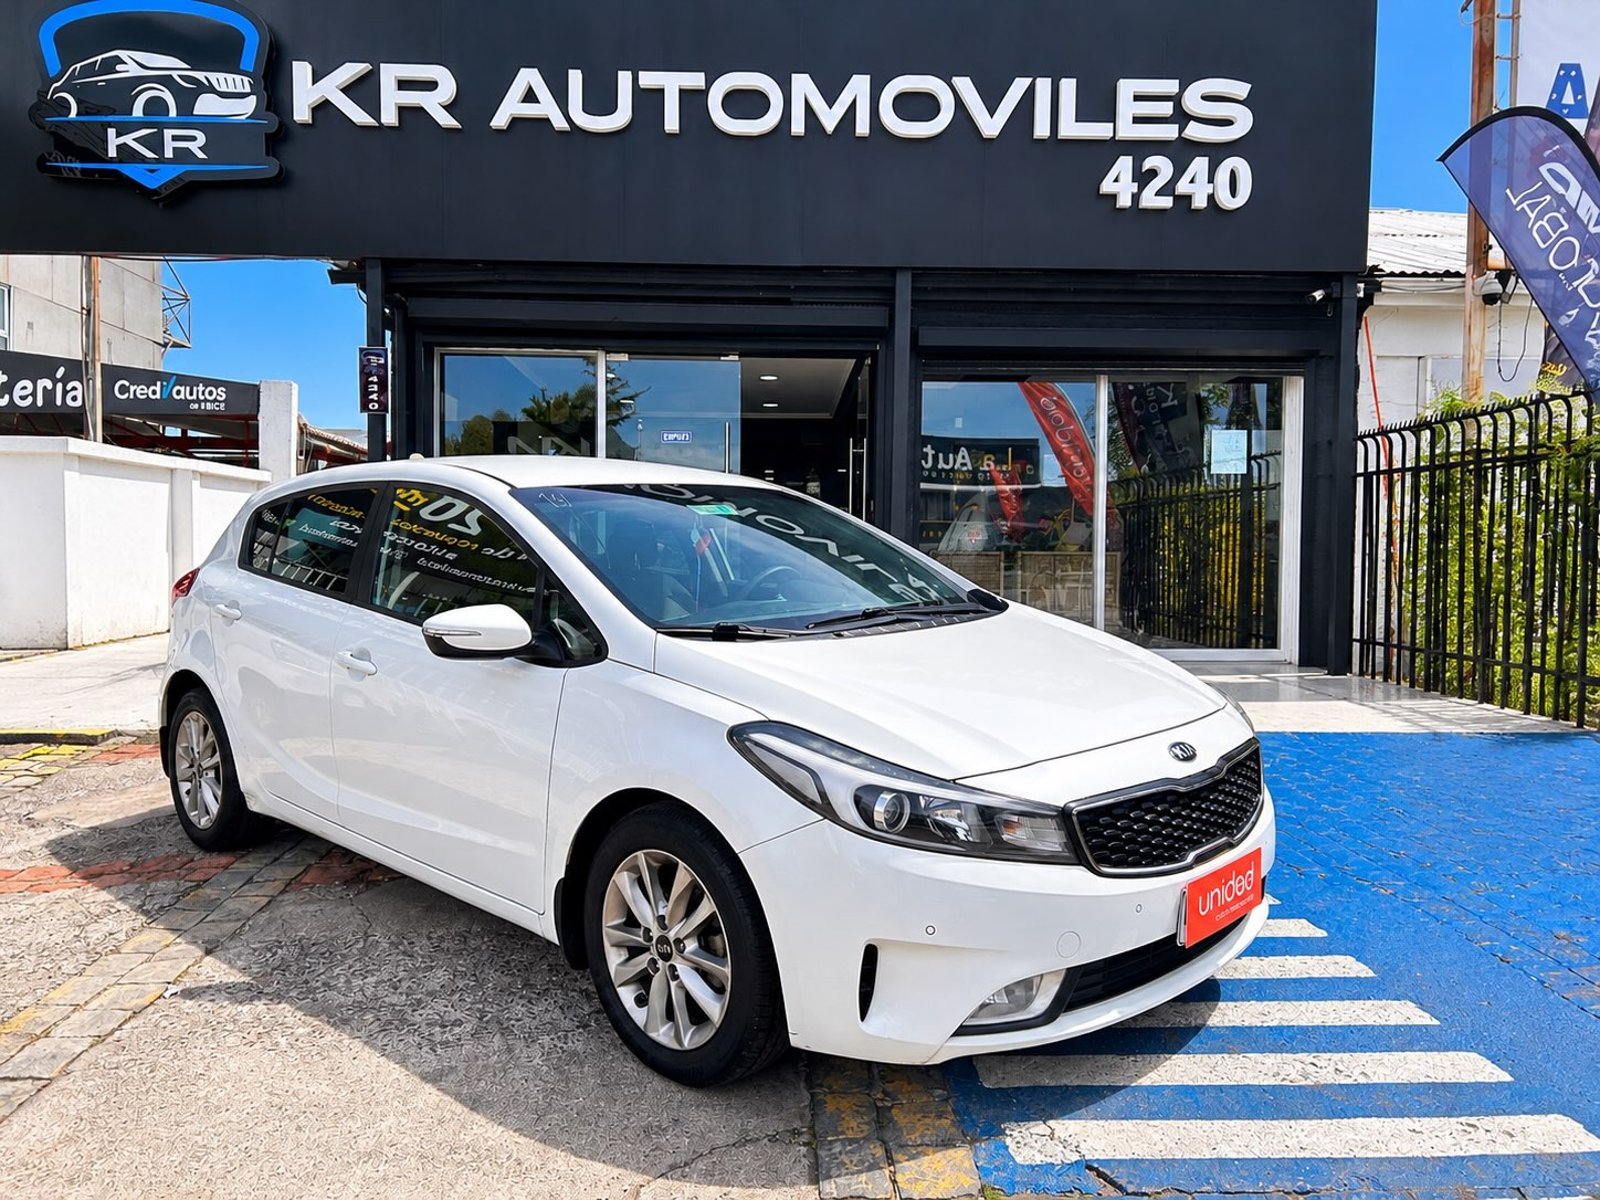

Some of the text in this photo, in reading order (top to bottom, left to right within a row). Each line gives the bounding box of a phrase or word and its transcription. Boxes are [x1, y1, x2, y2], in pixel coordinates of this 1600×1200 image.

[292, 61, 1254, 143] KR AUTOMOVILES
[107, 128, 209, 159] KR
[1099, 155, 1254, 211] 4240
